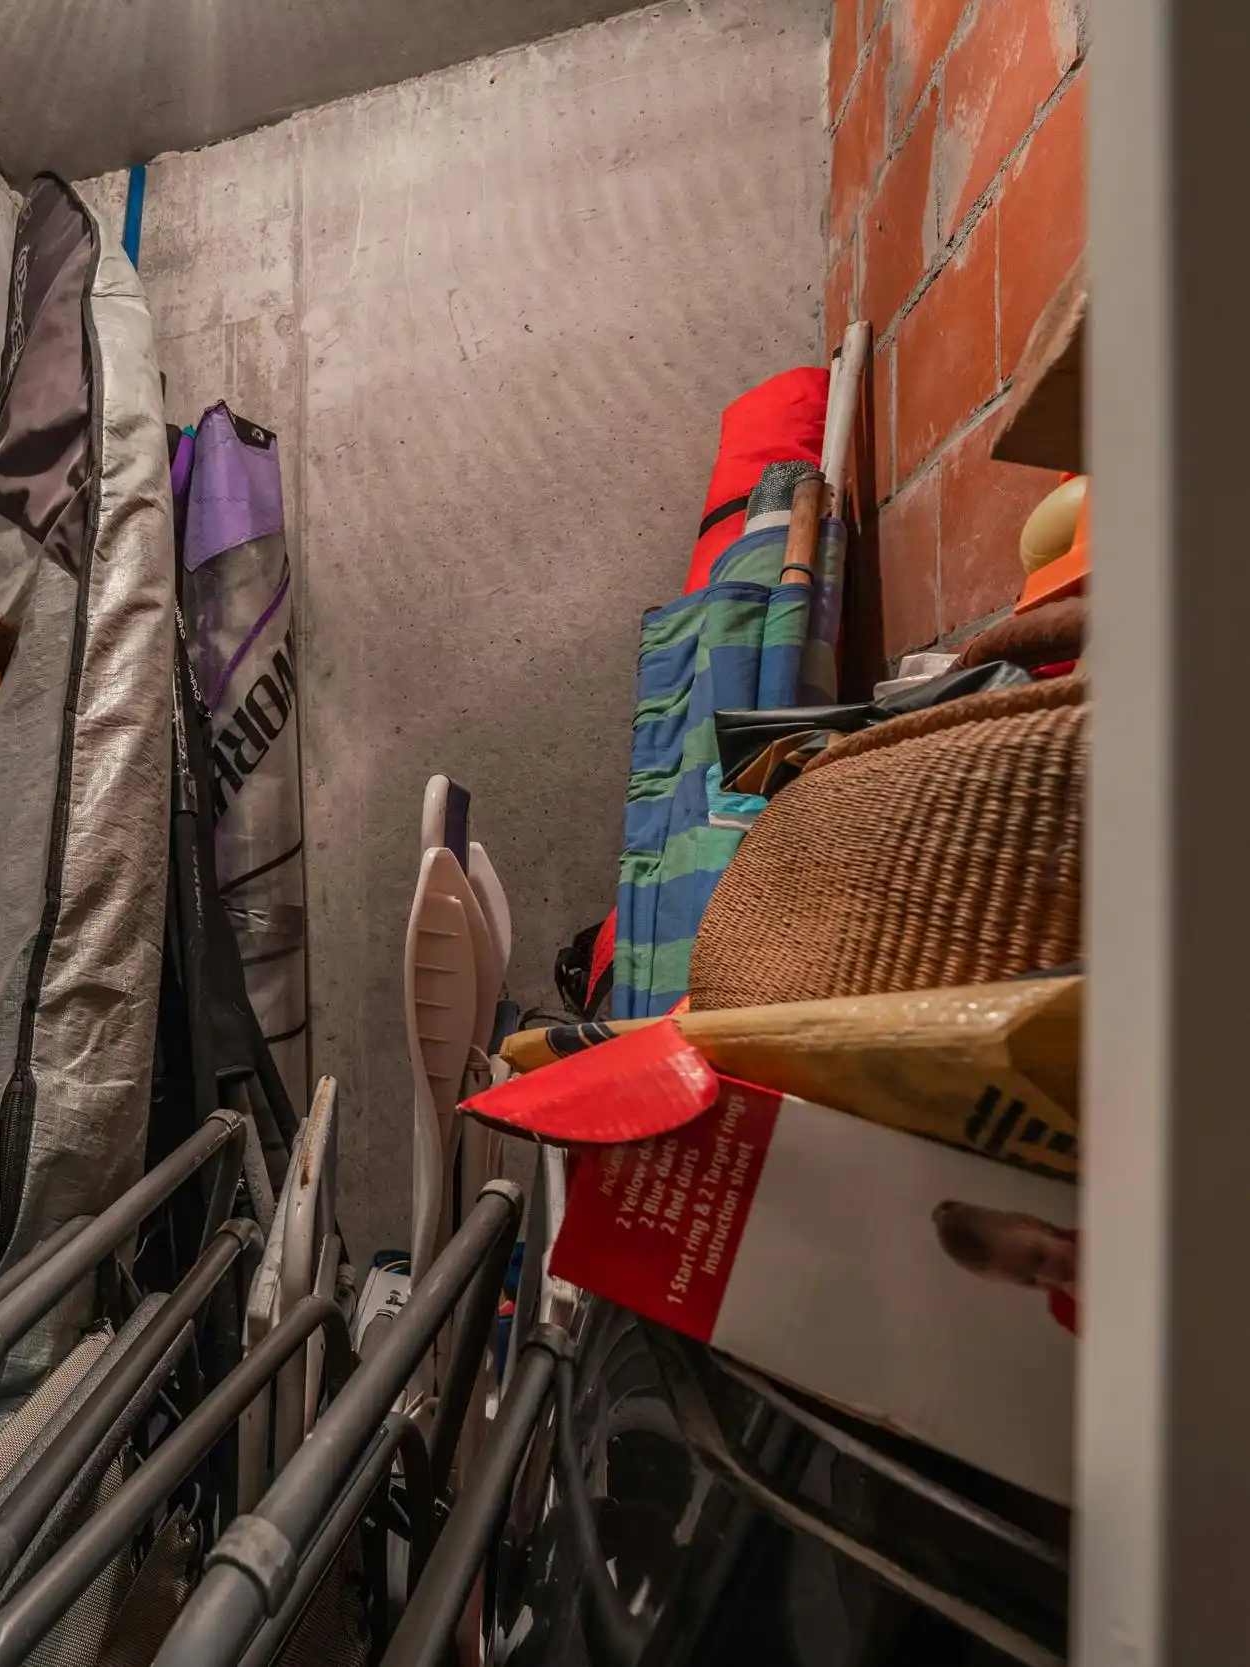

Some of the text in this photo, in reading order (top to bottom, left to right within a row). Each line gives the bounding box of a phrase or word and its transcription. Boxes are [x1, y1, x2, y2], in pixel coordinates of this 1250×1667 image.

[615, 1216, 632, 1230] 2
[619, 1162, 648, 1213] Yellow
[637, 1138, 679, 1229] 2 Blue darts
[660, 1148, 700, 1236] 2 Red darts
[666, 1094, 746, 1305] 1 Start ring & 2 Target rings
[700, 1141, 755, 1276] Instruction sheet
